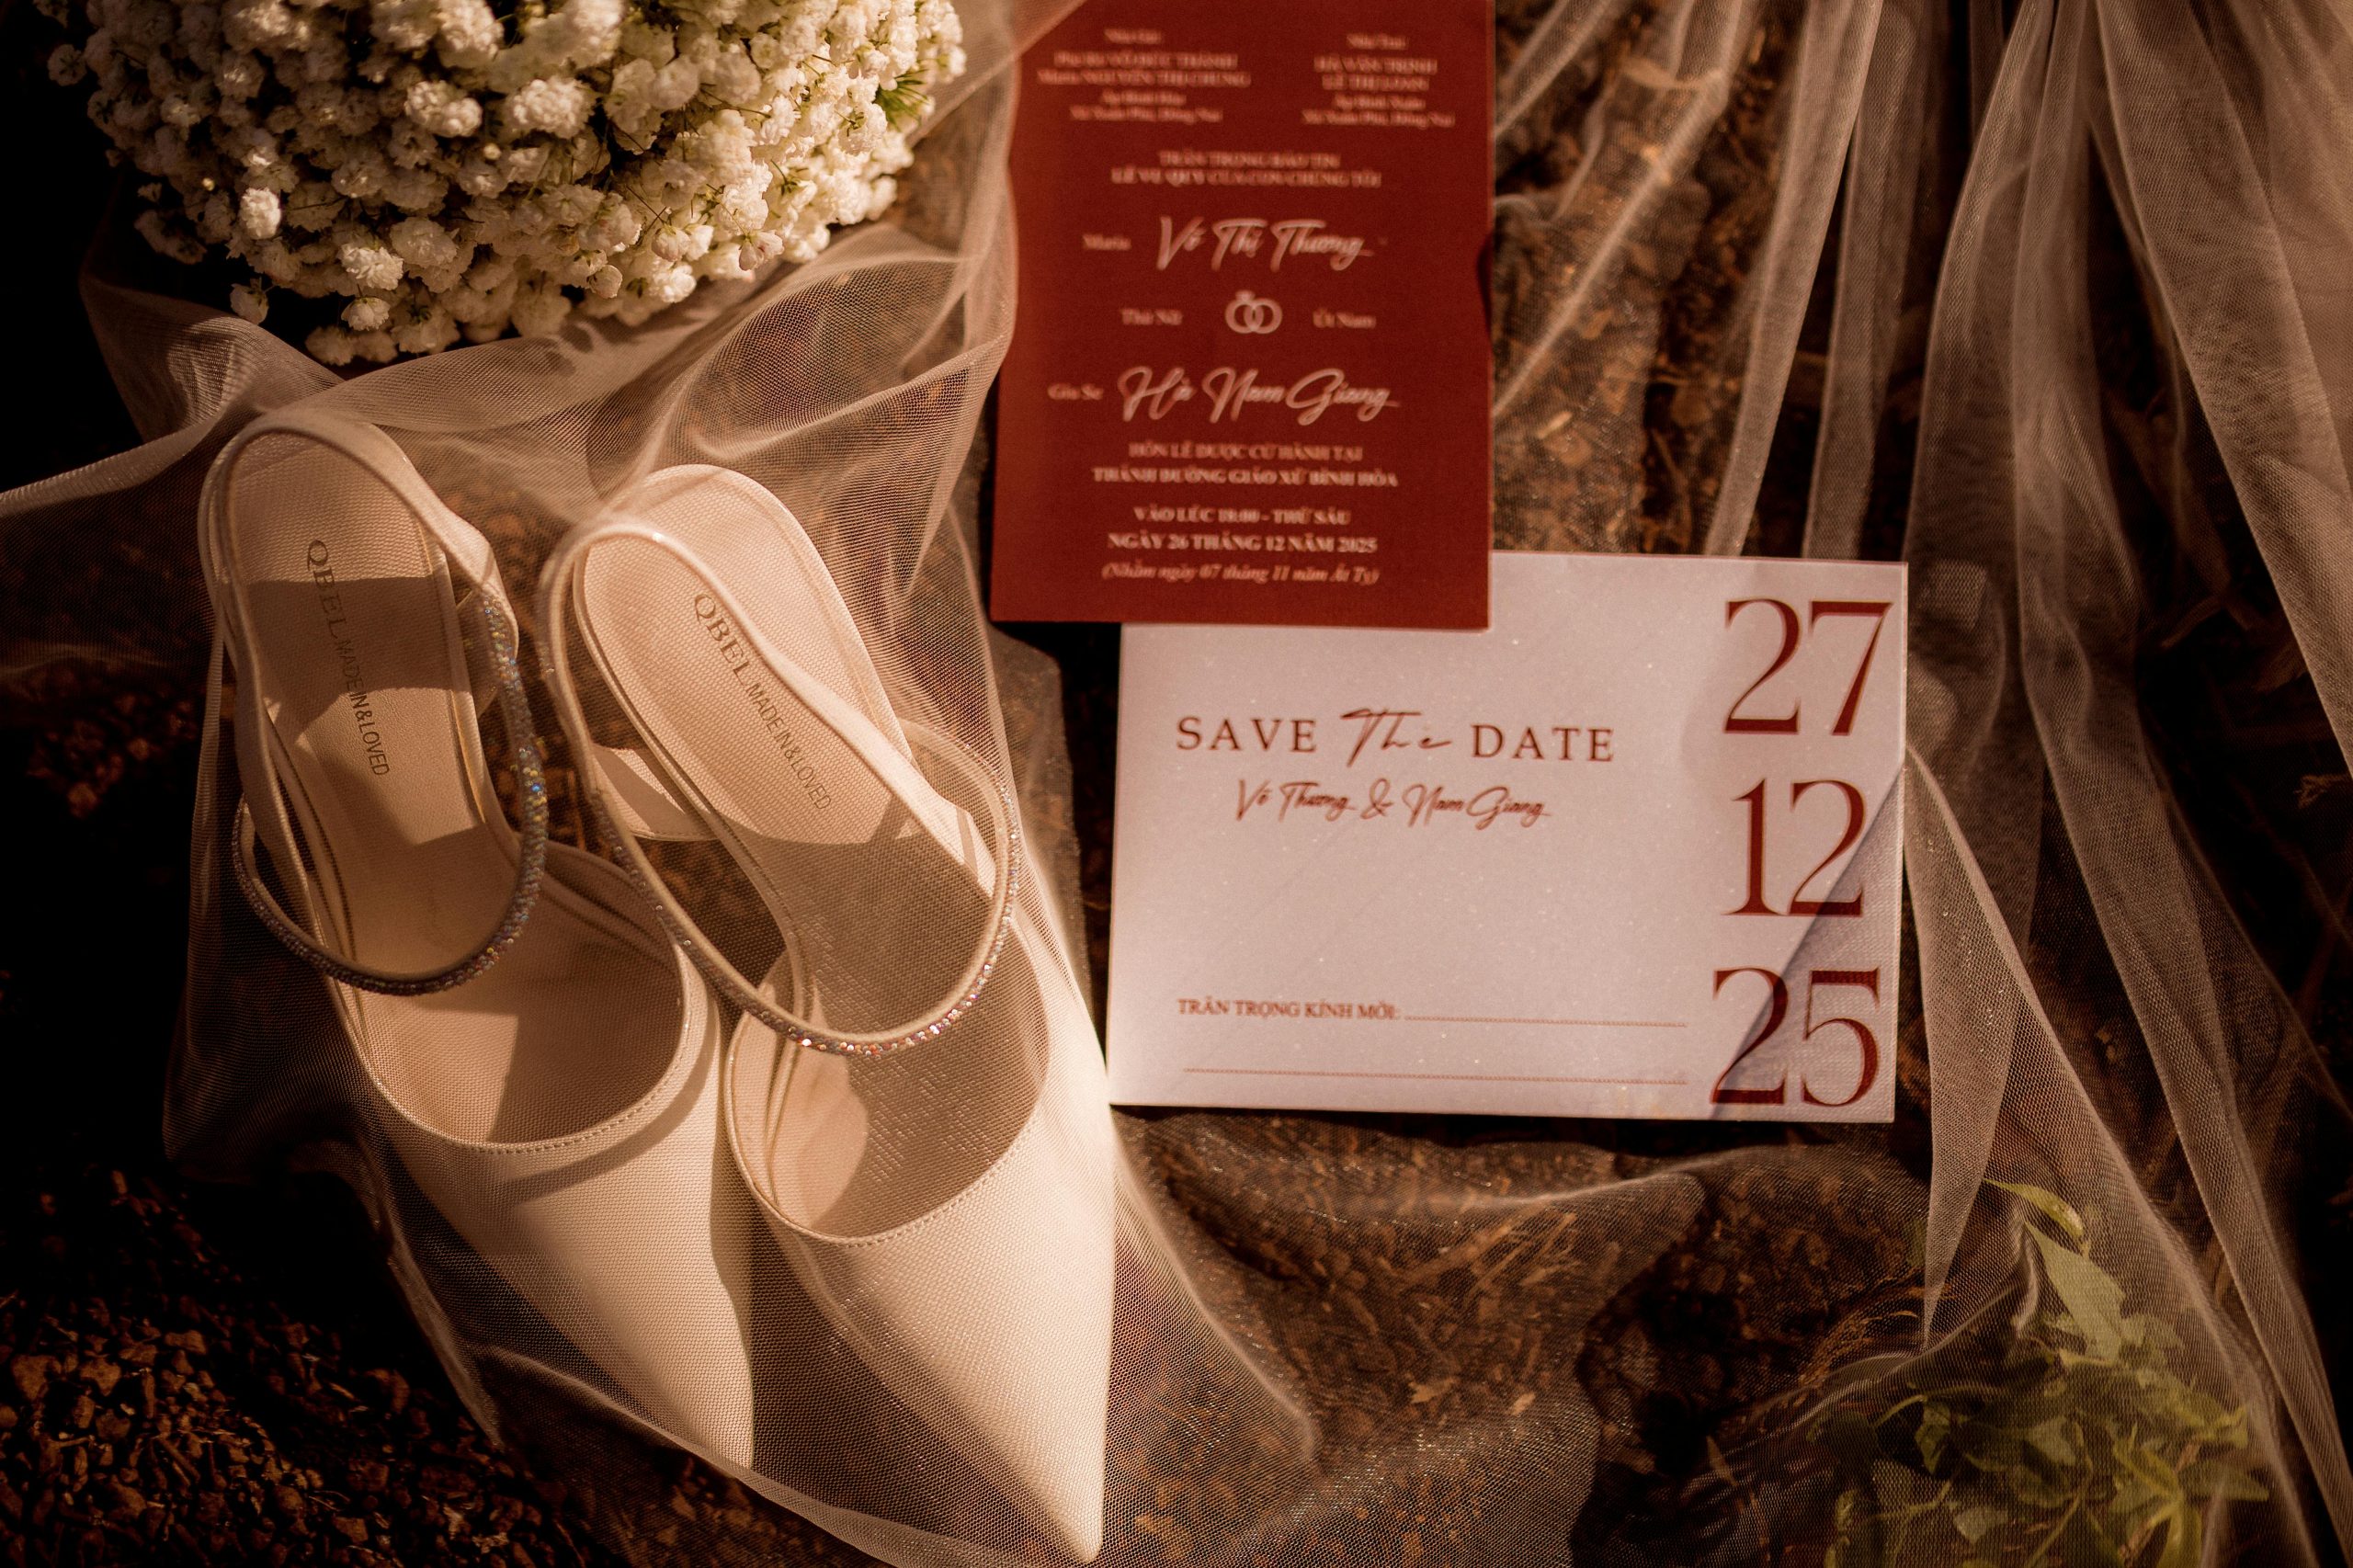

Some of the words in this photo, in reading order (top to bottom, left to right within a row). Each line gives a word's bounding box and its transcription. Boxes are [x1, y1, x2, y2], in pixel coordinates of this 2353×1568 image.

[1200, 366, 1285, 424] Nam
[1285, 367, 1400, 426] Giang
[1108, 528, 1165, 550] NGÀY
[1192, 530, 1261, 551] THÁNG
[1266, 536, 1285, 551] 12
[1287, 532, 1335, 552] NĂM
[306, 540, 347, 640] QBEL
[695, 593, 750, 687] QBEL
[1722, 597, 1893, 736] 27
[1176, 717, 1317, 753] SAVE
[1340, 708, 1452, 767] The
[1472, 724, 1615, 763] DATE
[1360, 778, 1393, 820] &
[1402, 784, 1465, 827] Nam
[1466, 787, 1552, 831] Giang
[1721, 777, 1870, 918] 12
[1177, 995, 1230, 1015] TRÂN
[1233, 998, 1301, 1019] TRỌNG
[1304, 998, 1353, 1019] KÍNH
[1710, 966, 1881, 1108] 25
